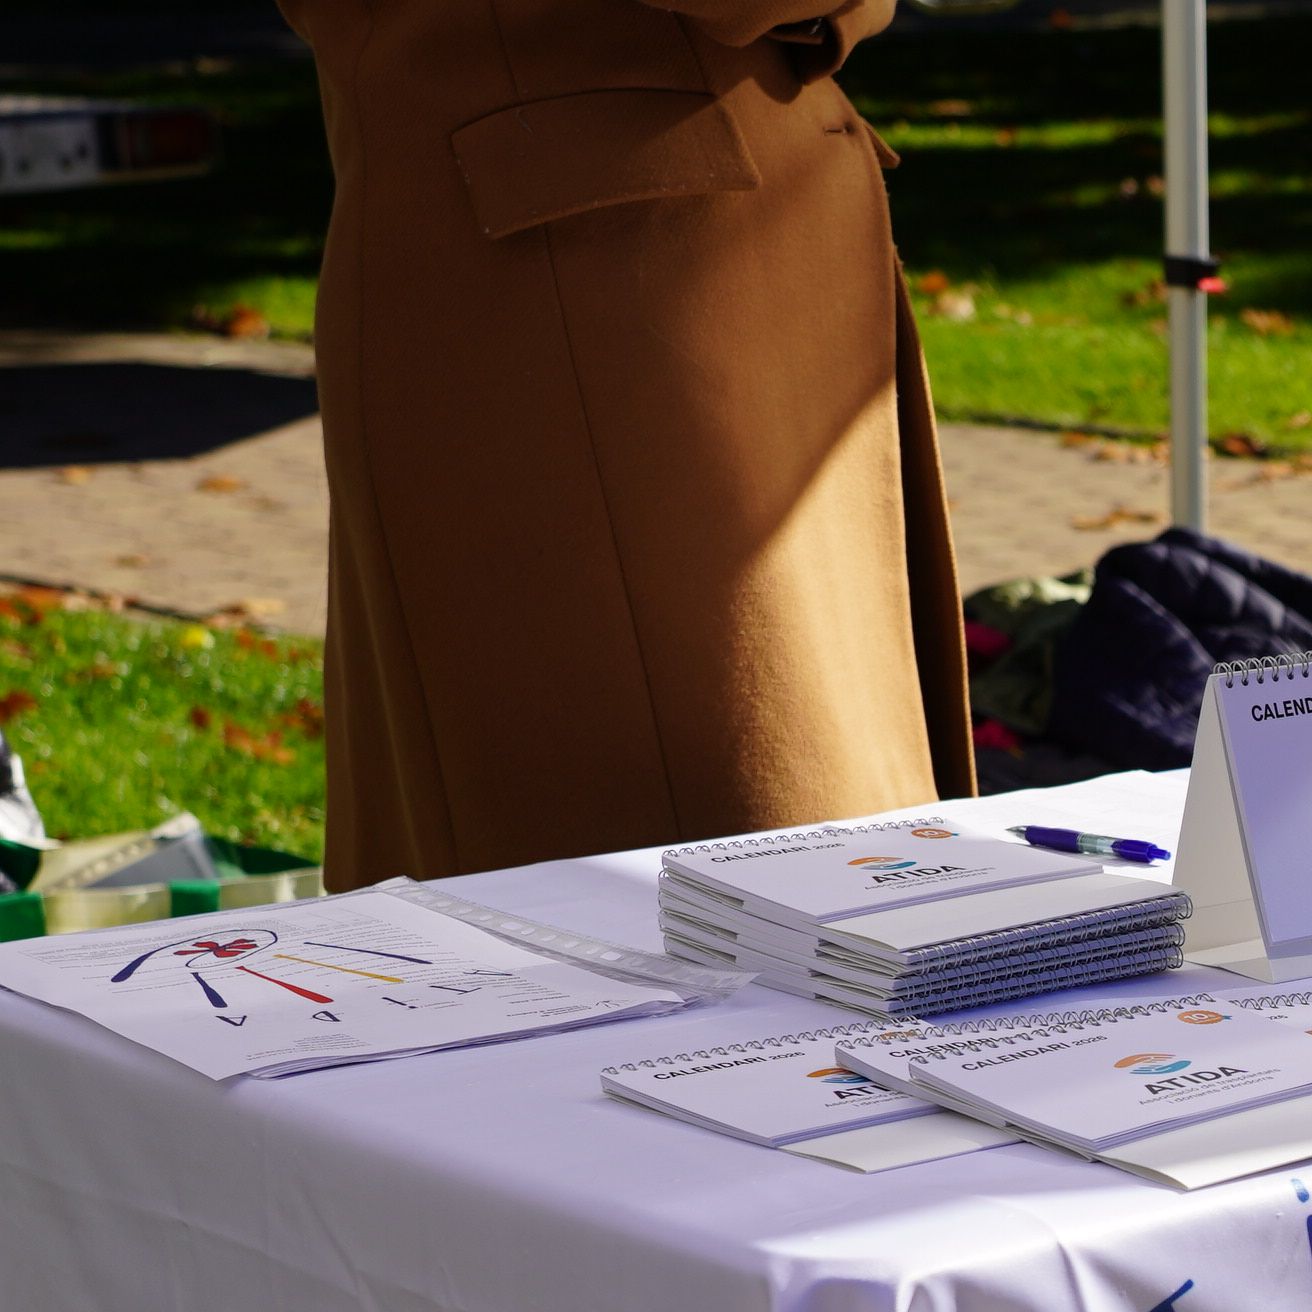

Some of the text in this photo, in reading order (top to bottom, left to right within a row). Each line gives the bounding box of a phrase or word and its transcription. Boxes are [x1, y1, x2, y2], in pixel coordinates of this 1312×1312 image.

[711, 845, 811, 863] CALENDARI
[872, 864, 966, 884] ATIDA
[961, 1035, 1108, 1070] CALENDARI 2026
[653, 1051, 806, 1080] CALENDARI 2026
[833, 1084, 892, 1099] ATI
[1143, 1066, 1249, 1095] ATIDA
